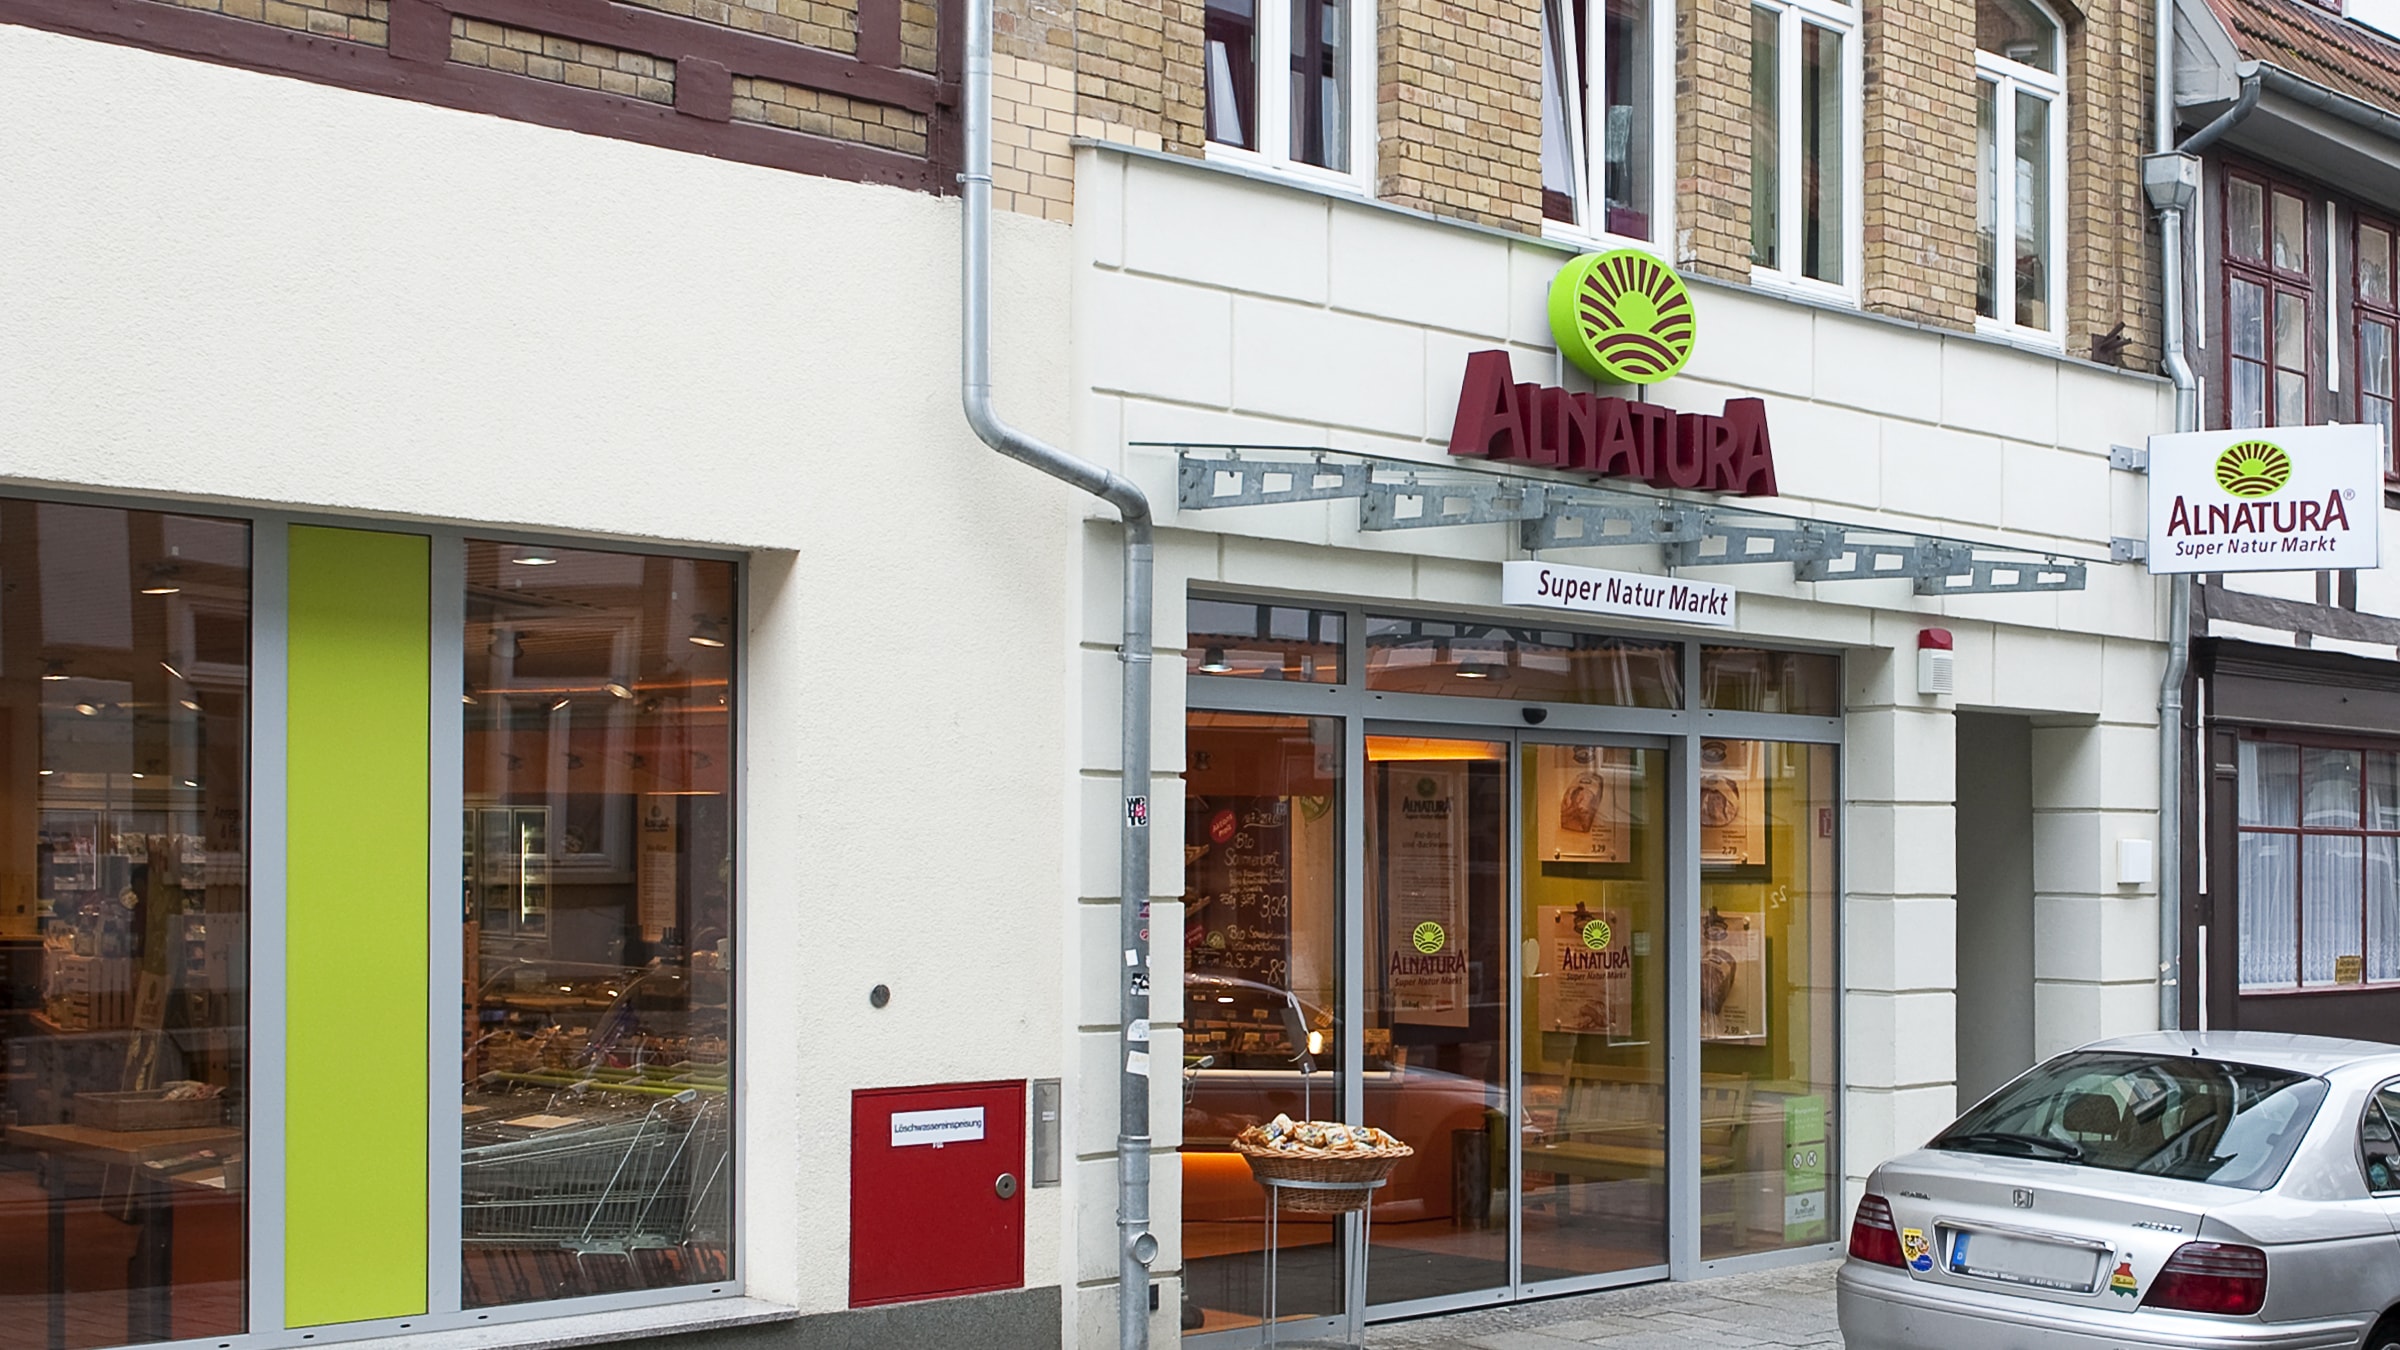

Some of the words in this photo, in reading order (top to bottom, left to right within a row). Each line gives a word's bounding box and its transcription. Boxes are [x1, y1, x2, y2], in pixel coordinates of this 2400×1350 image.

[1448, 349, 1778, 497] ALNATURA
[2175, 539, 2224, 559] Super
[2227, 538, 2278, 554] Natur
[2281, 535, 2337, 552] Markt
[1537, 569, 1600, 610] Super
[1606, 576, 1666, 612] Natur
[1668, 583, 1729, 617] Markt
[1390, 949, 1466, 975] ALNATURA
[1562, 945, 1630, 971] ALNATURA
[1394, 977, 1417, 988] Super
[1418, 977, 1440, 985] Natur
[1440, 976, 1463, 985] Markt
[1566, 973, 1586, 981] Super
[1586, 972, 1606, 980] Natur
[1607, 971, 1627, 979] Markt
[894, 1119, 983, 1134] Löschwassereinspeisung
